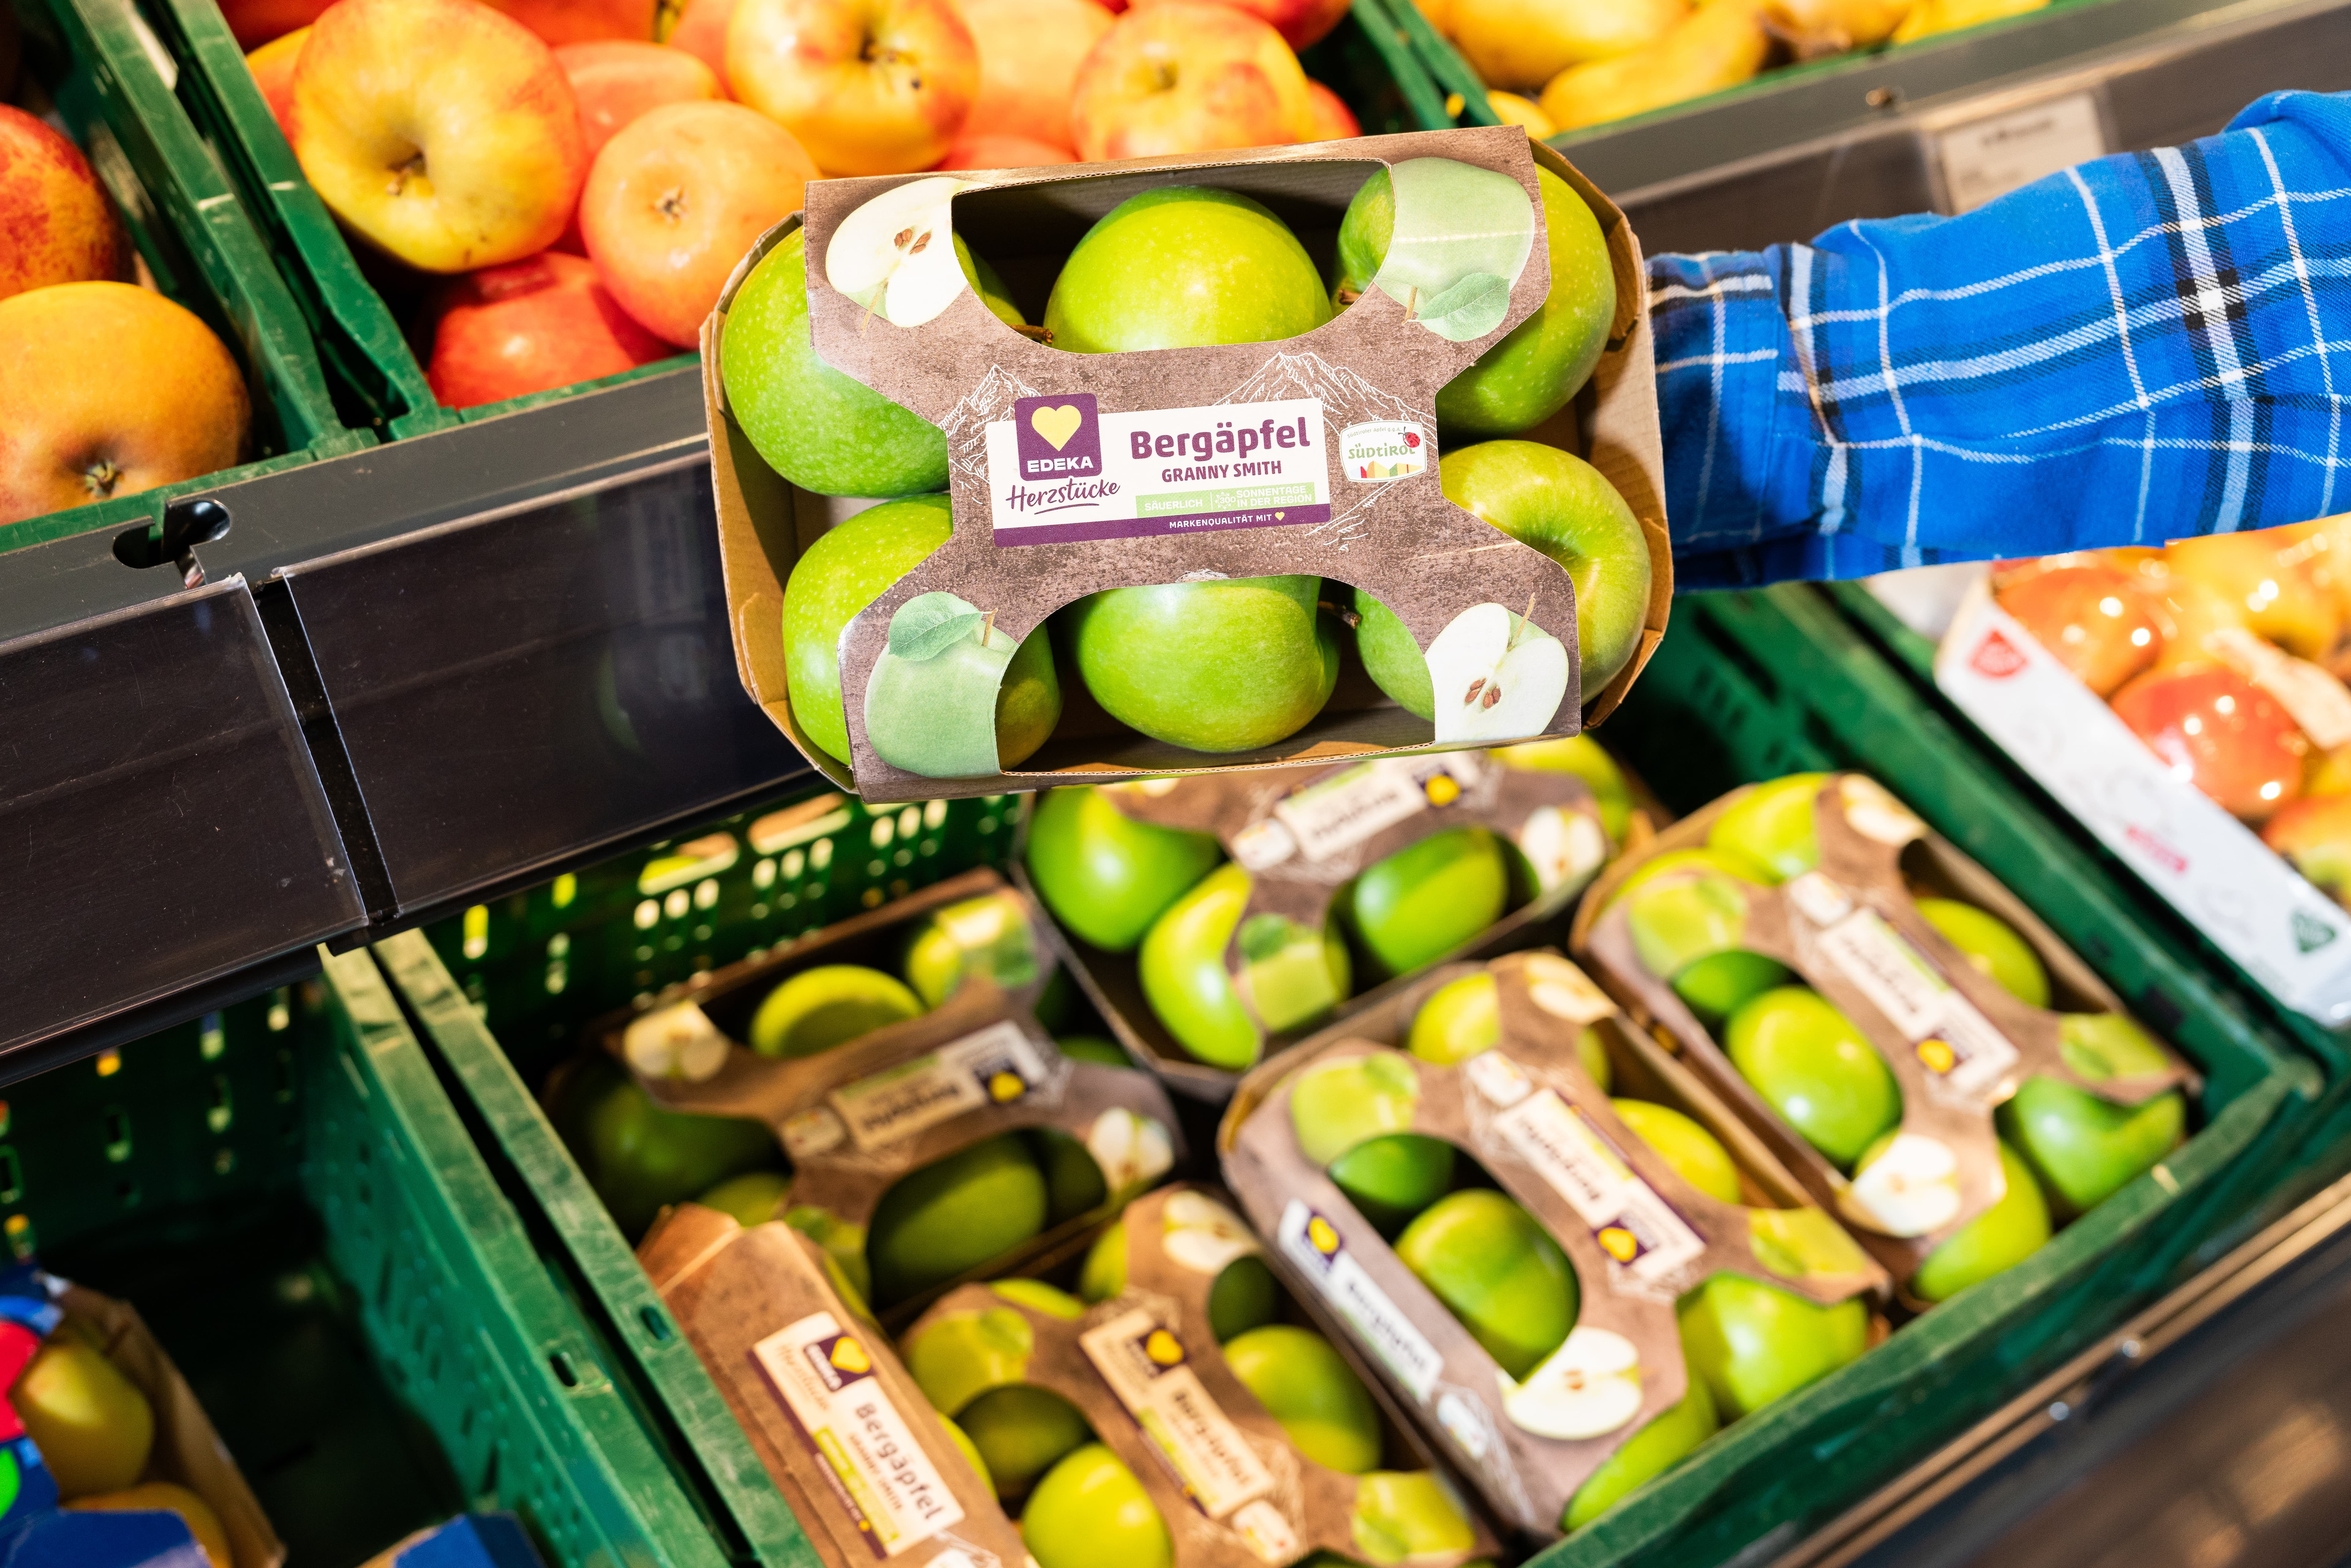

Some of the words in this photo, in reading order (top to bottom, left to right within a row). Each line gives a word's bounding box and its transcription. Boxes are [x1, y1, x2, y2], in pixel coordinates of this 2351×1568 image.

[1130, 417, 1310, 461] Bergäpfel
[1347, 429, 1372, 438] Südtiroler
[1027, 456, 1094, 473] EDEKA
[1162, 464, 1229, 482] GRANNY
[1234, 460, 1282, 477] SMITH
[1006, 478, 1120, 512] Herzstücke
[1236, 485, 1306, 498] SONNENTAGE
[1144, 498, 1203, 511] SÄUERLICH
[1237, 499, 1247, 507] IN
[1250, 497, 1271, 506] DER
[1273, 494, 1312, 504] REGION
[1169, 514, 1253, 528] MARKENQUALITÄT
[856, 1401, 944, 1520] Bergäpfel
